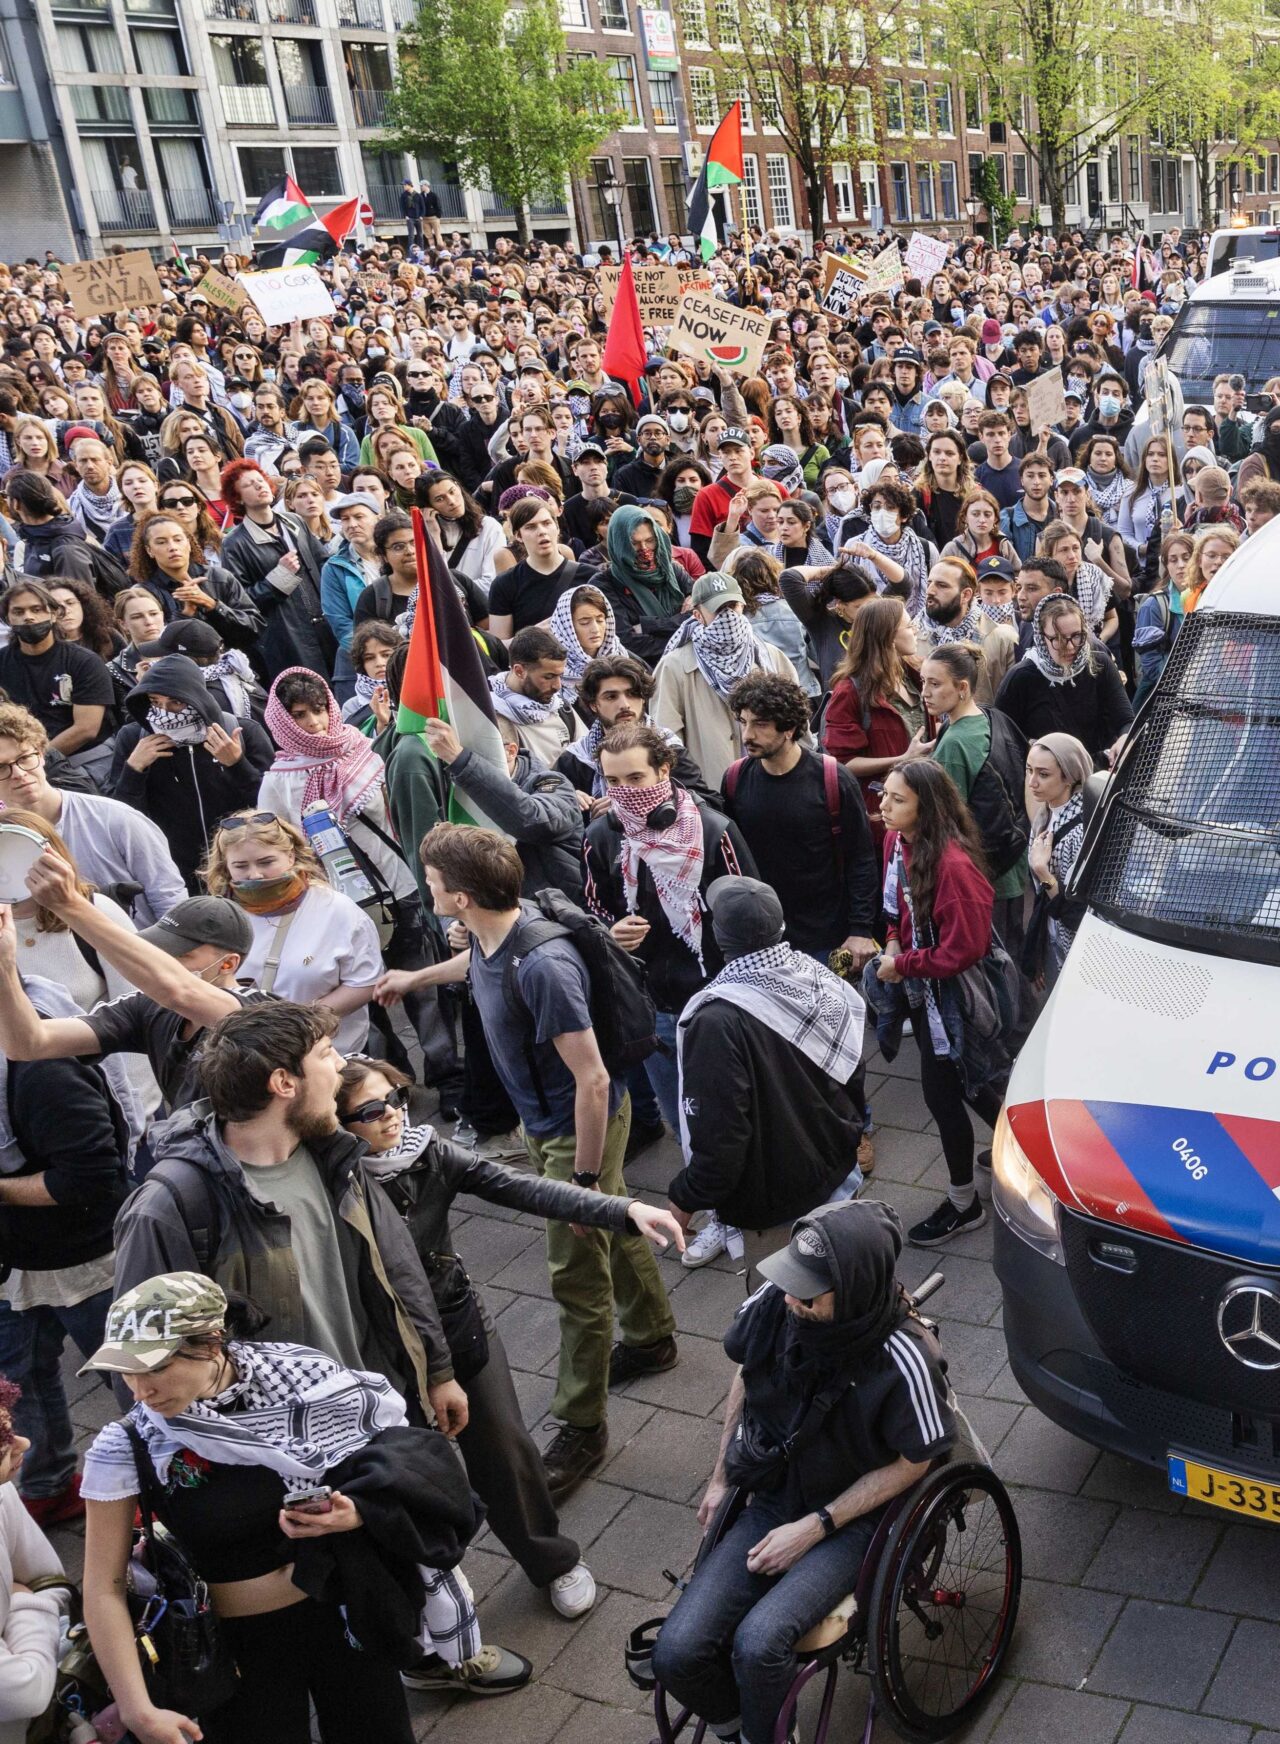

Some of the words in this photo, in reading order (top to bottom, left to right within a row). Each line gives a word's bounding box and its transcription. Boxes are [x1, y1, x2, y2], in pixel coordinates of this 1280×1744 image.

[72, 257, 130, 283] SAVE
[644, 270, 666, 282] NOT
[678, 270, 701, 284] REE
[215, 276, 238, 294] FREE
[635, 282, 656, 294] REE
[836, 270, 865, 291] JUSTICE
[86, 275, 154, 306] GAZA
[639, 295, 654, 305] ALL
[654, 294, 666, 305] OF
[666, 295, 679, 306] US
[823, 295, 852, 316] NOW
[648, 307, 675, 320] FREE
[683, 296, 766, 338] CEASEFIRE
[678, 314, 728, 345] NOW
[719, 428, 744, 440] ICON
[712, 578, 728, 592] NY
[1172, 1137, 1208, 1180] 0406
[107, 1308, 182, 1343] EACE
[1172, 1477, 1185, 1488] NL
